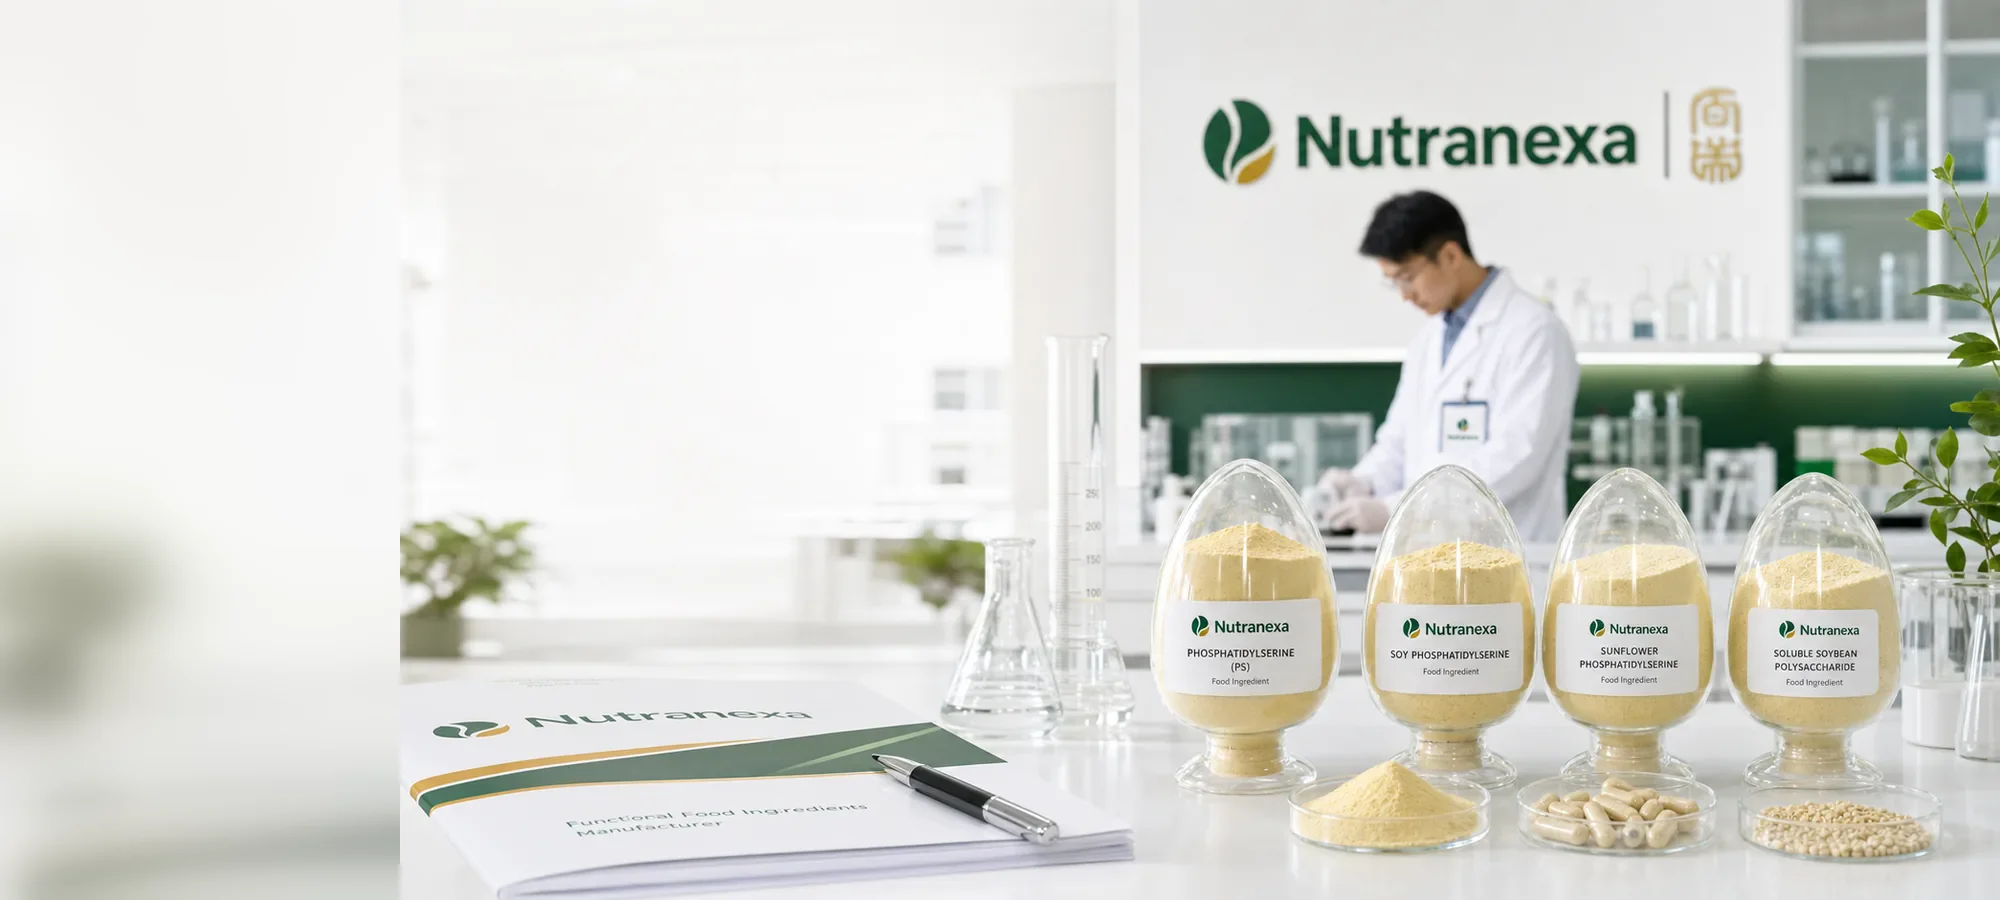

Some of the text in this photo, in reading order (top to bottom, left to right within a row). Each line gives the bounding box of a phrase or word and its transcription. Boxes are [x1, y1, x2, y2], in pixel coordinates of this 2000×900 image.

[1295, 113, 1638, 170] Nutranexa
[1085, 521, 1102, 532] 200
[1085, 554, 1102, 565] 150
[1085, 588, 1102, 598] 100
[1213, 619, 1290, 634] Nutranexa
[1425, 622, 1498, 636] Nutranexa
[1609, 622, 1669, 635] Nutranexa
[1799, 624, 1860, 637] Nutranexa
[1187, 647, 1296, 659] PHOSPHATIDYLSERINE
[1390, 649, 1510, 660] SOY PHOSPHATIDYLSERINE
[1600, 646, 1659, 656] SUNFLOWER
[1773, 648, 1858, 659] SOLUBLE SOYBEAN
[1230, 661, 1251, 674] (PS)
[1579, 659, 1680, 670] PHOSPHATIDYLSERINE
[1774, 661, 1856, 672] POLYSACCHARIDE
[1422, 667, 1480, 678] Food Ingredient
[1211, 677, 1270, 688] Food Ingredient
[1600, 675, 1658, 686] Food Ingredient
[1785, 678, 1844, 689] Food Ingredient
[524, 709, 813, 728] Nutranexa
[566, 812, 674, 828] Functional
[681, 809, 735, 819] Food
[576, 820, 723, 837] Manufacturer
